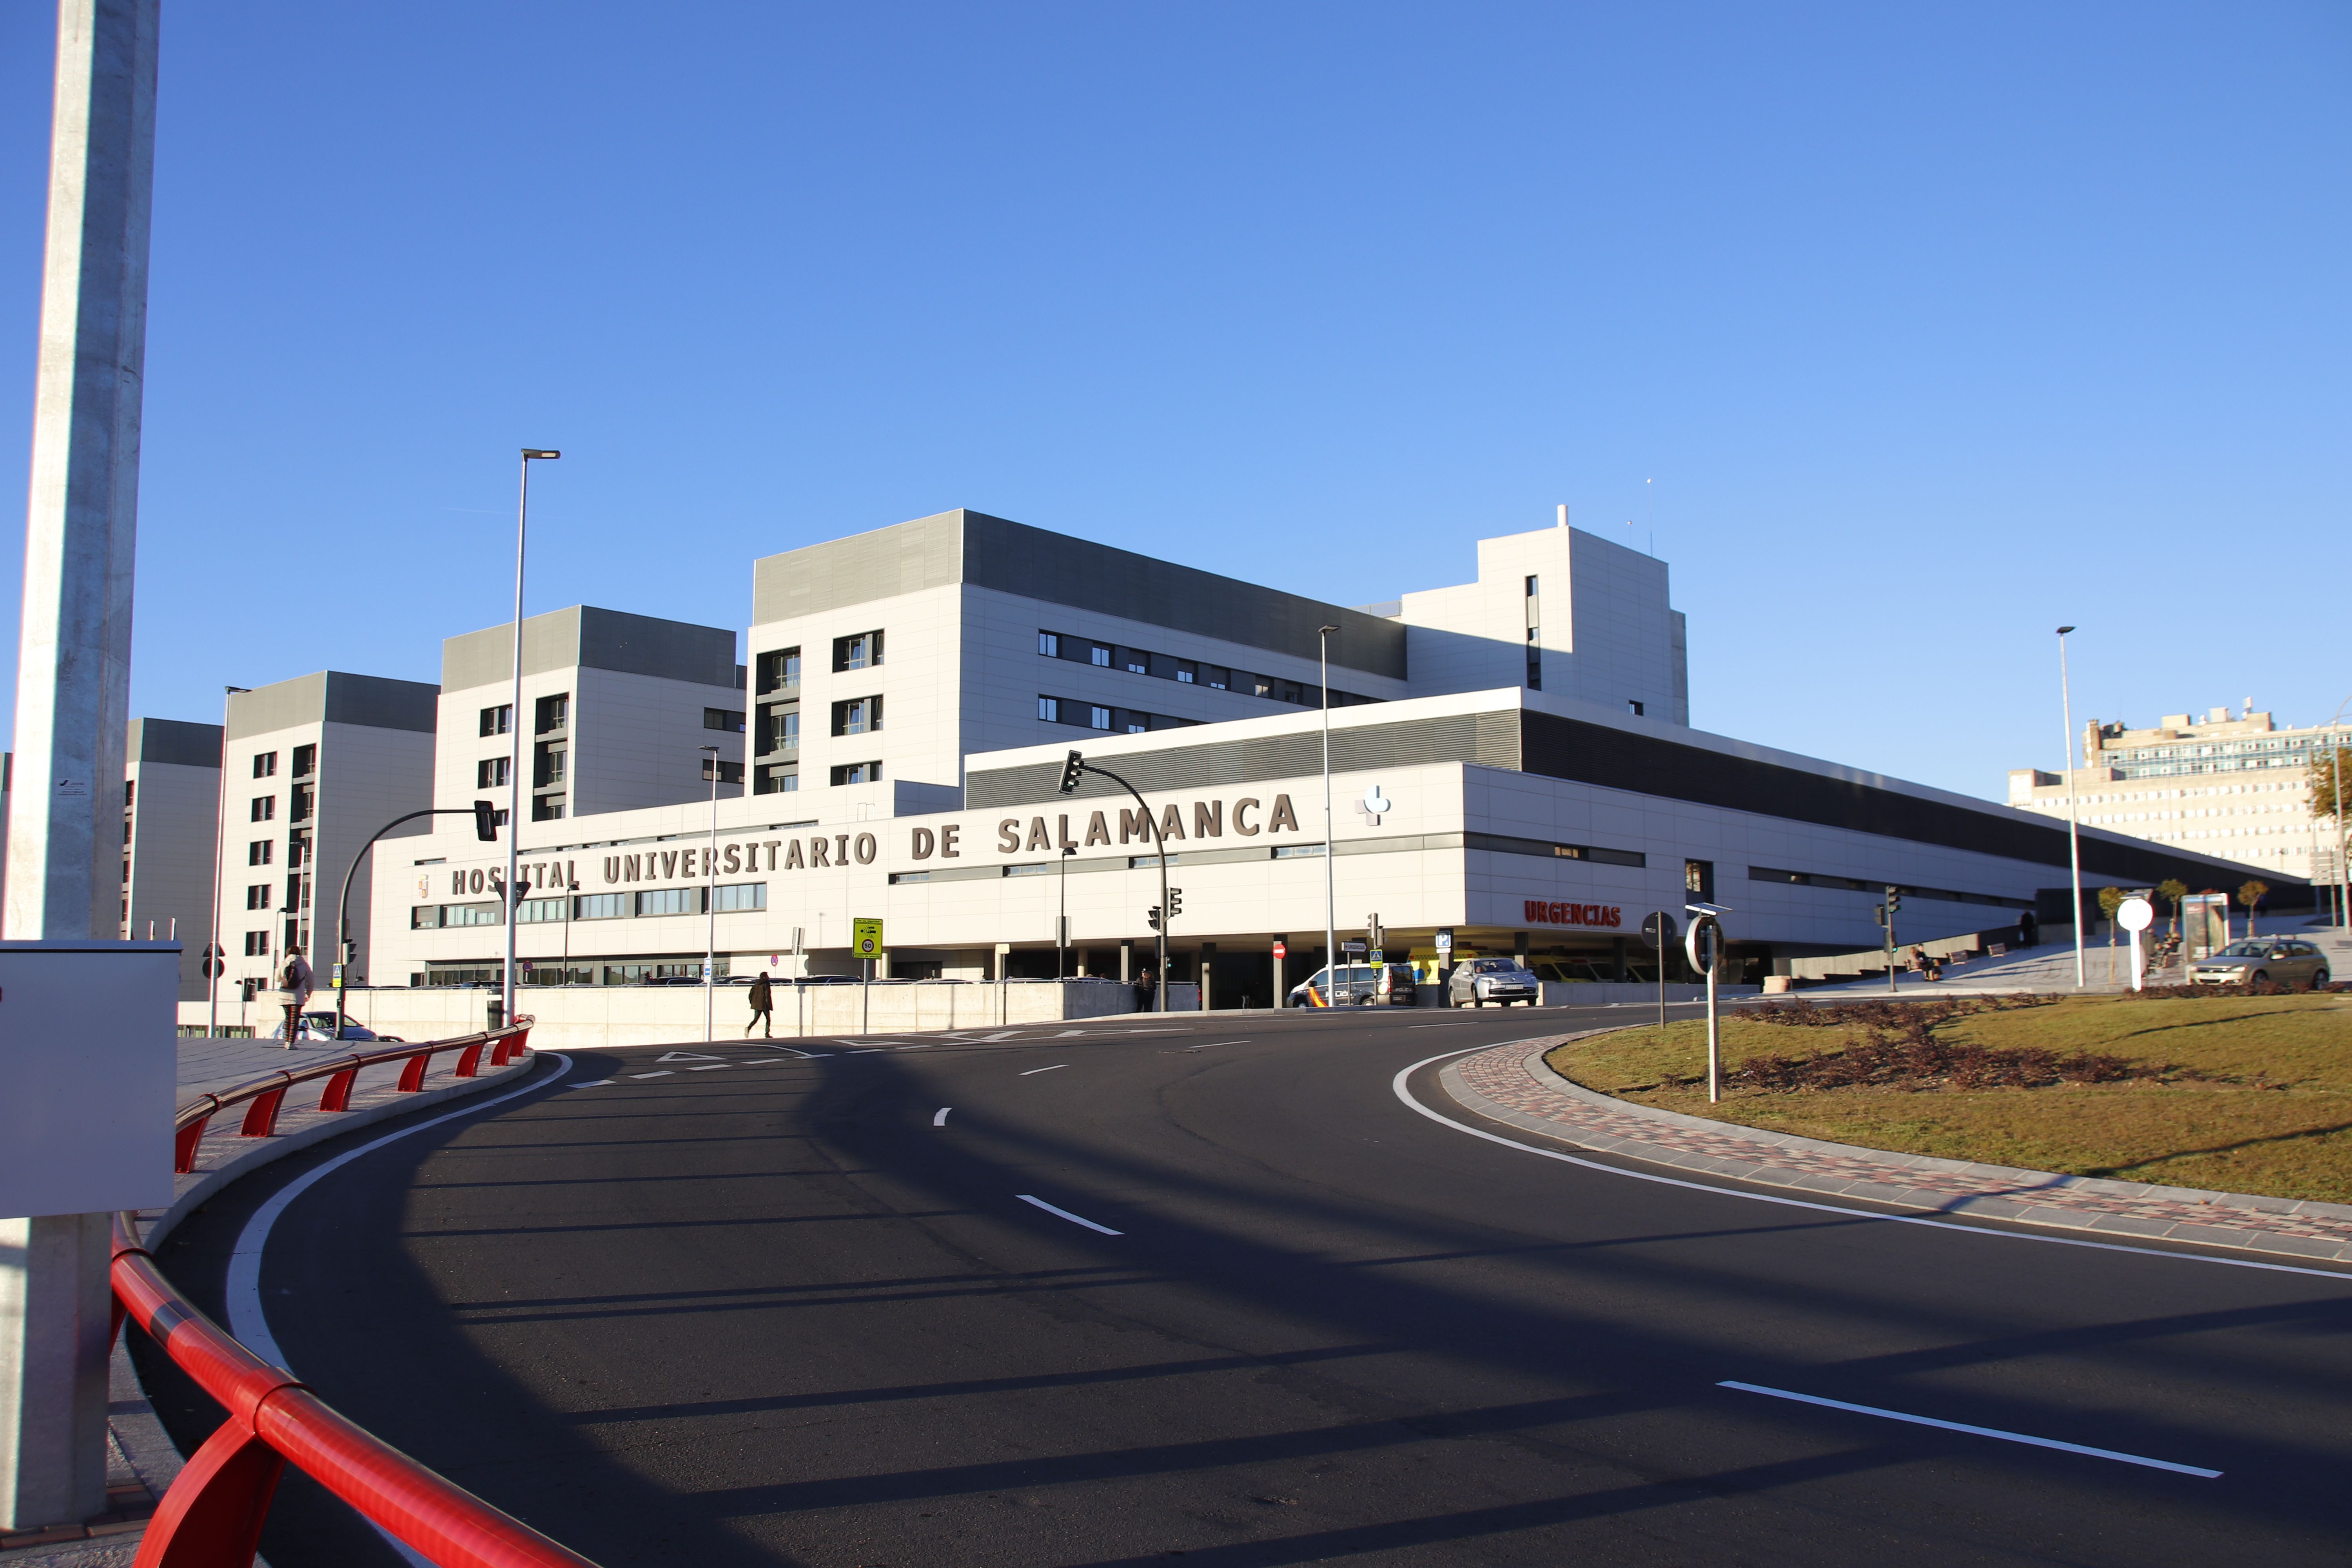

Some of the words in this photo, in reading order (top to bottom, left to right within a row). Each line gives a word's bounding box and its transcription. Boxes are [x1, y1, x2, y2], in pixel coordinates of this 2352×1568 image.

[452, 860, 579, 895] HOSITAL
[604, 832, 877, 884] UNIVERSITARIO
[912, 824, 960, 860] DE
[998, 794, 1299, 853] SALAMANCA
[1525, 900, 1621, 927] URGENCIAS
